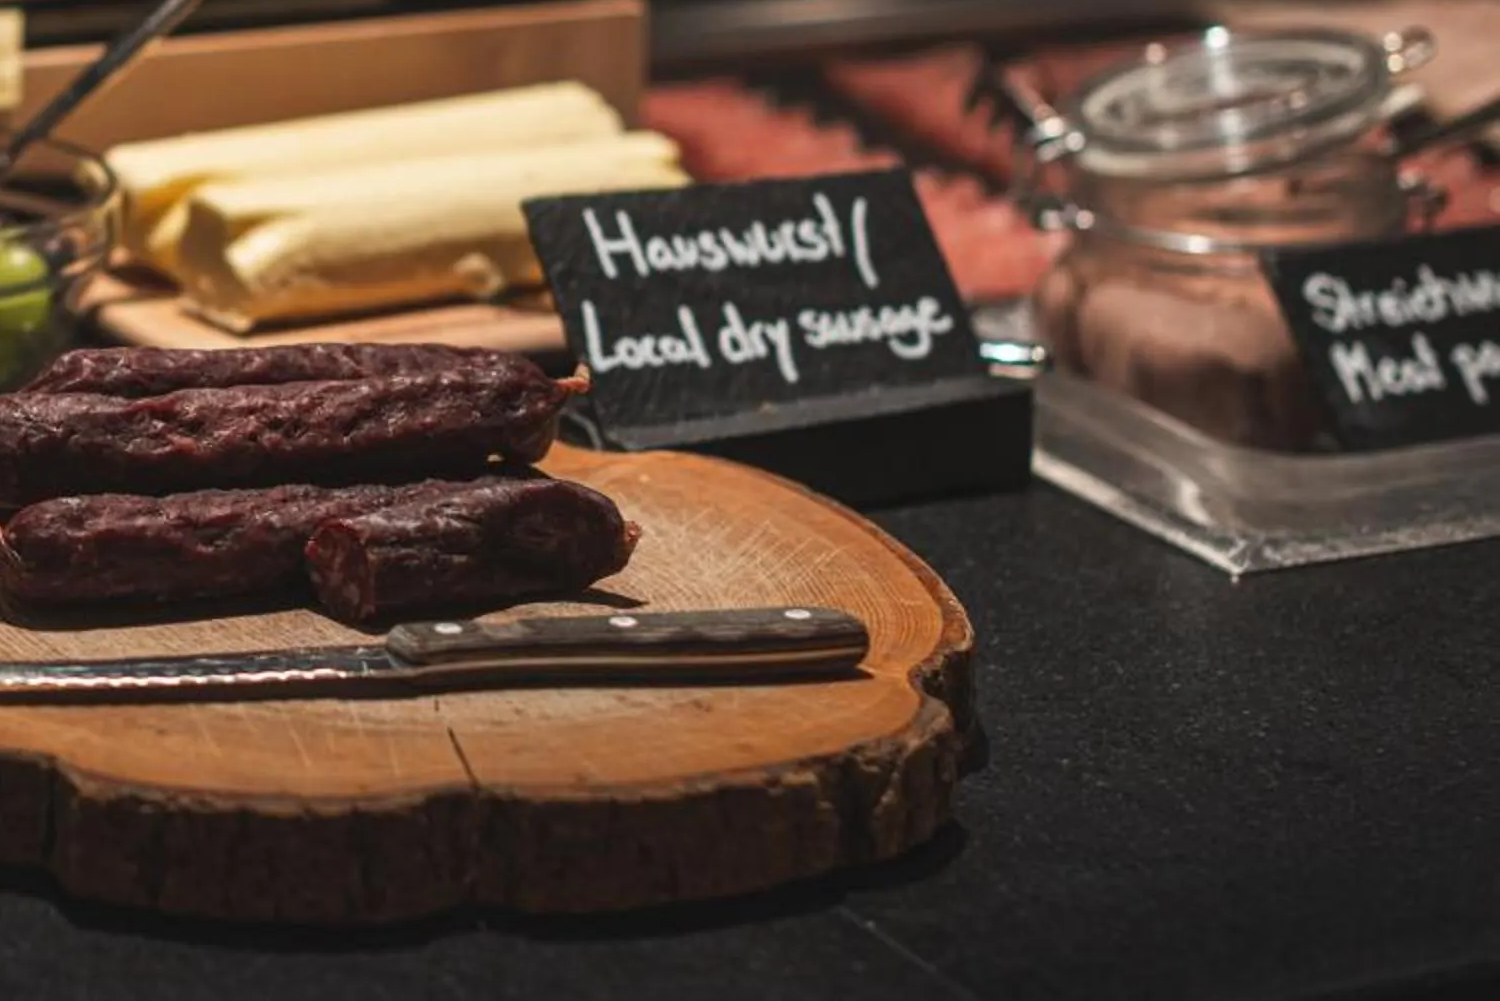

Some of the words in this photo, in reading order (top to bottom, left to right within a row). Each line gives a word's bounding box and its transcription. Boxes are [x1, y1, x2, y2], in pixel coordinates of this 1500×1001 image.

[582, 301, 711, 373] Local
[719, 302, 799, 382] dry
[800, 298, 953, 358] sausage
